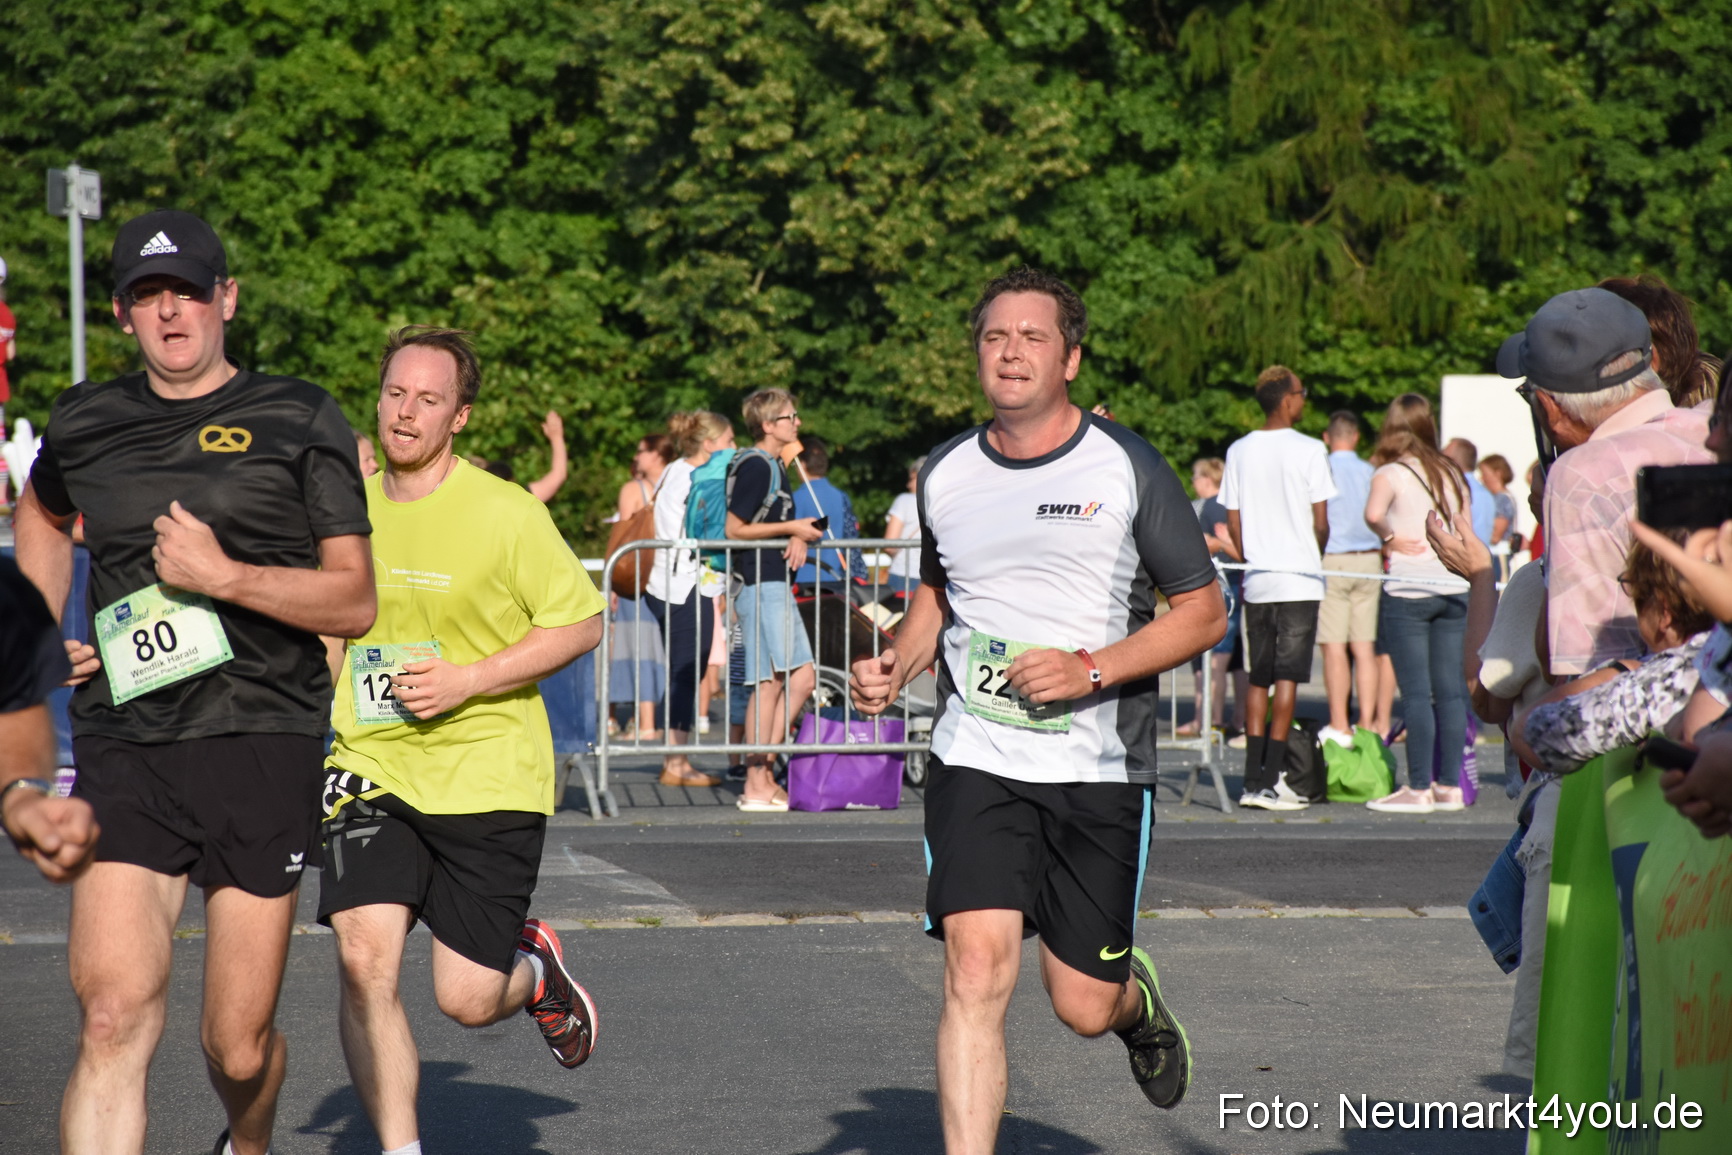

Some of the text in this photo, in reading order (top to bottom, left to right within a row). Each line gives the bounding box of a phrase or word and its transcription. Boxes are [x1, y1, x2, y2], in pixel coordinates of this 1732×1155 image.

[140, 245, 178, 257] adidas
[1036, 503, 1082, 516] swn
[111, 607, 150, 634] firmenlauf
[132, 620, 178, 662] 80
[130, 646, 199, 679] Wendlik Harald
[362, 658, 395, 669] firmenlauf
[377, 702, 394, 710] Marx
[991, 697, 1017, 710] Gailler
